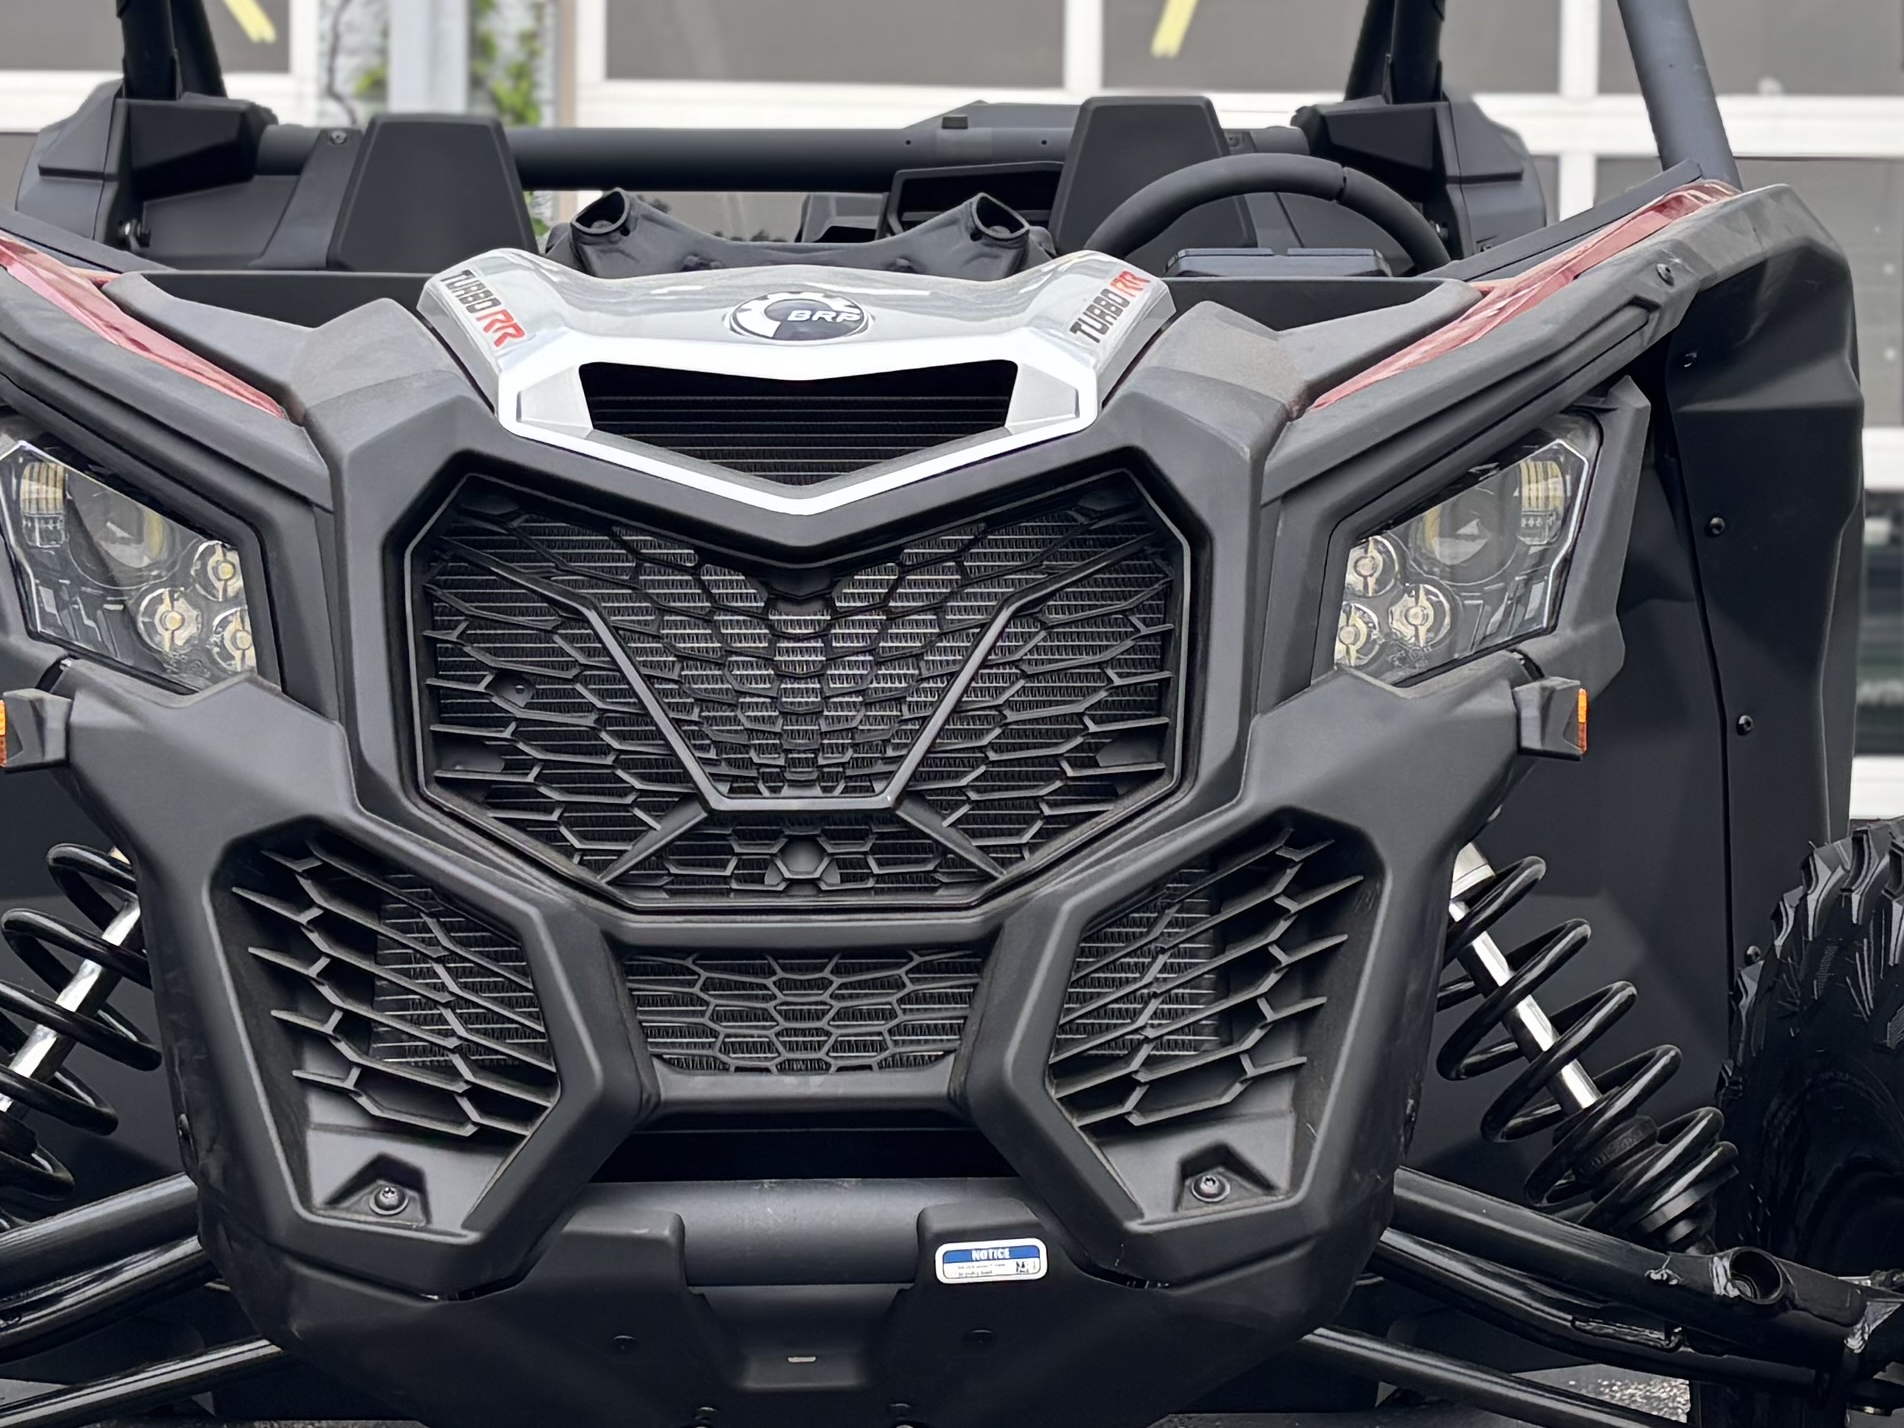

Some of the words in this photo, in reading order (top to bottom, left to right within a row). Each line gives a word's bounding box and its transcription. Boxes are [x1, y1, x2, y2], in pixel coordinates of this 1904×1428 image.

[439, 269, 502, 314] TURBO
[475, 308, 526, 348] RR
[787, 310, 861, 323] BRP
[1069, 288, 1131, 344] TURBO
[1109, 270, 1151, 298] RR
[971, 1247, 1010, 1261] NOTICE
